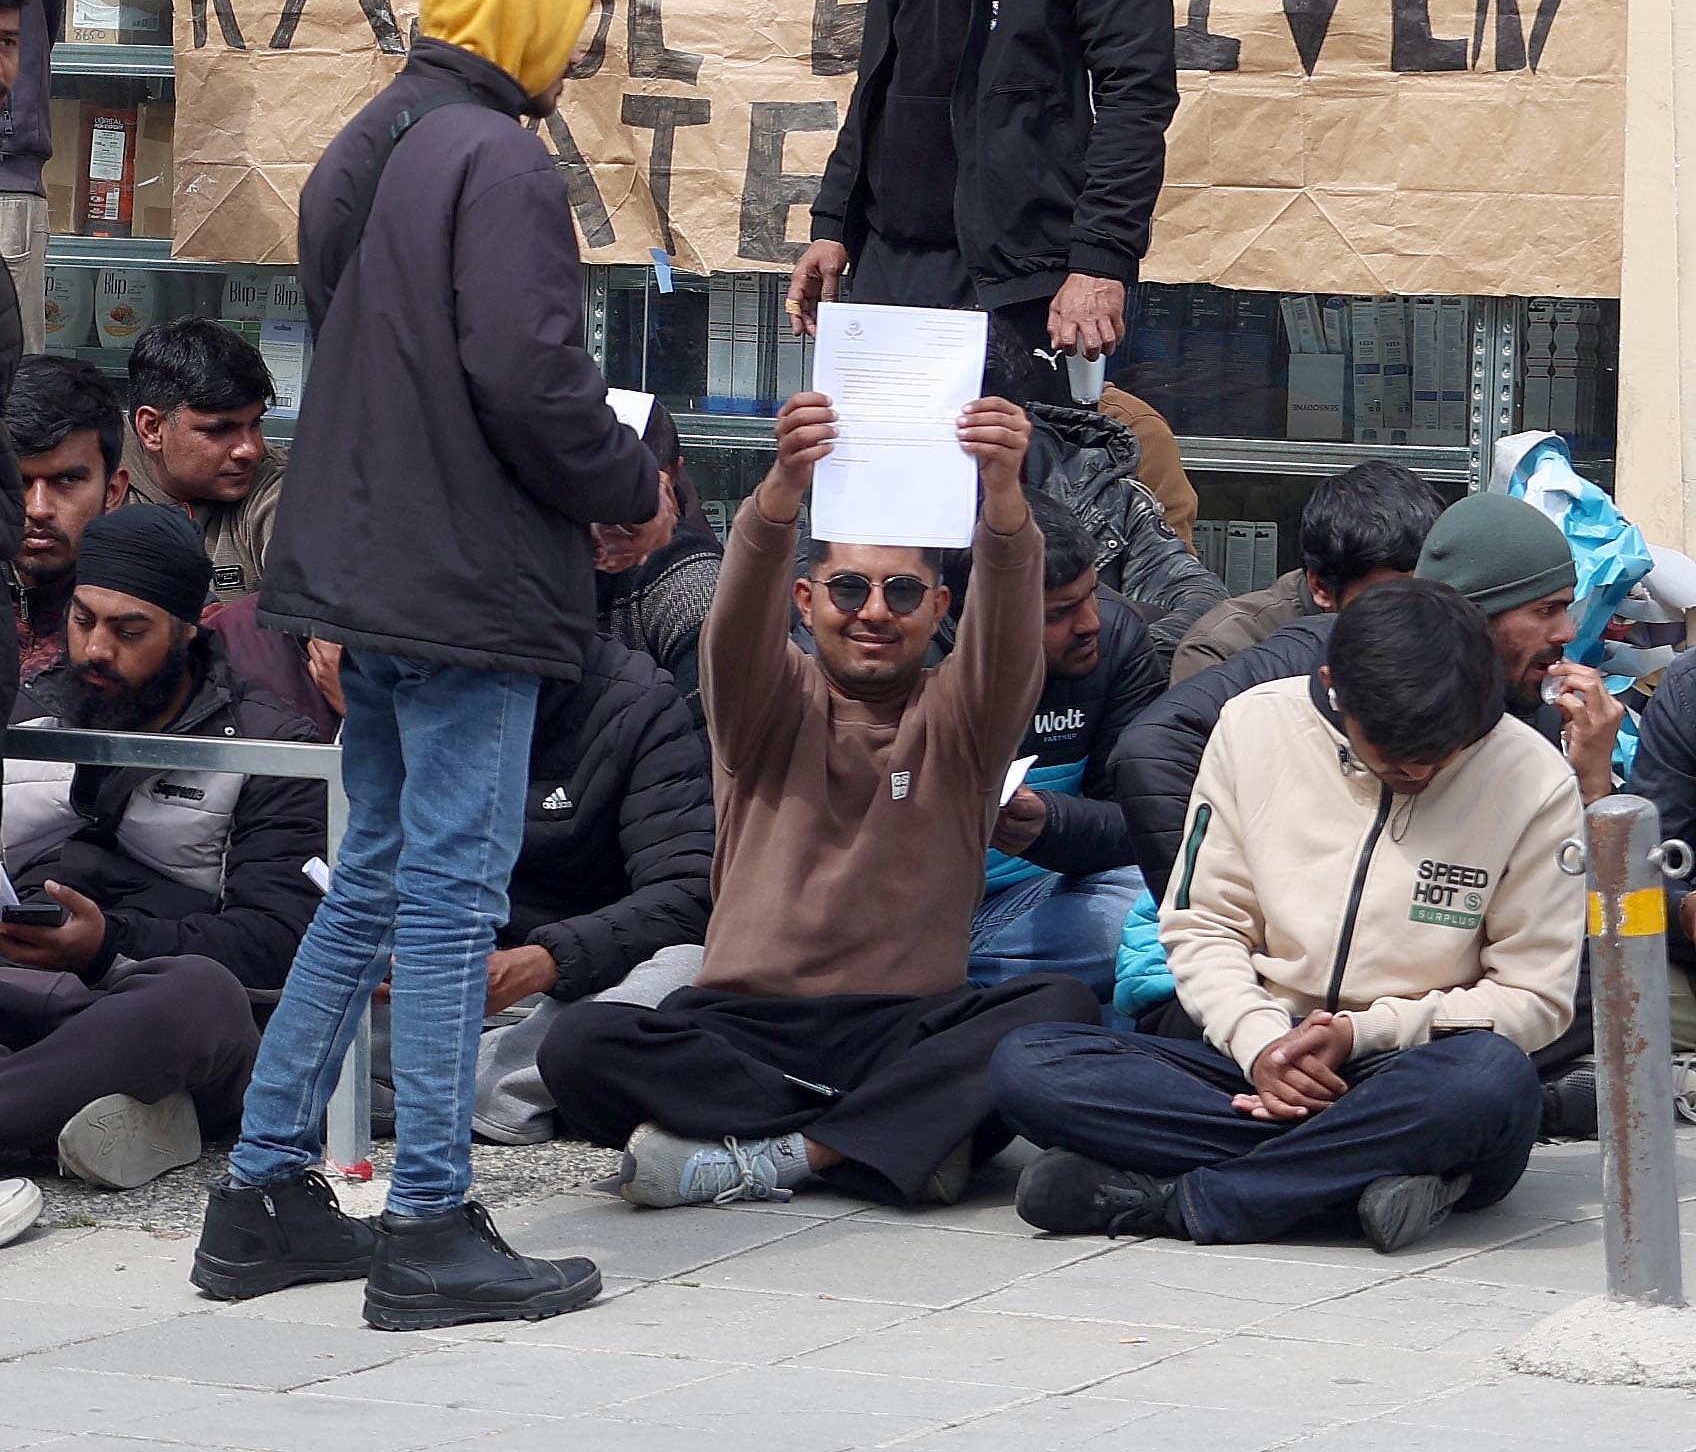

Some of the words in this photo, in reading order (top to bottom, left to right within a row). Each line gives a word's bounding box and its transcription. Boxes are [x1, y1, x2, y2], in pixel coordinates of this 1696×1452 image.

[1292, 402, 1341, 413] SENSODYNE
[1033, 708, 1085, 735] Wolt
[1044, 731, 1078, 745] PARTNER
[153, 779, 206, 802] Supreme
[542, 800, 573, 810] adidas
[1416, 858, 1489, 889] SPEED
[1412, 880, 1459, 909] HOT
[1417, 908, 1478, 927] SURPLUS
